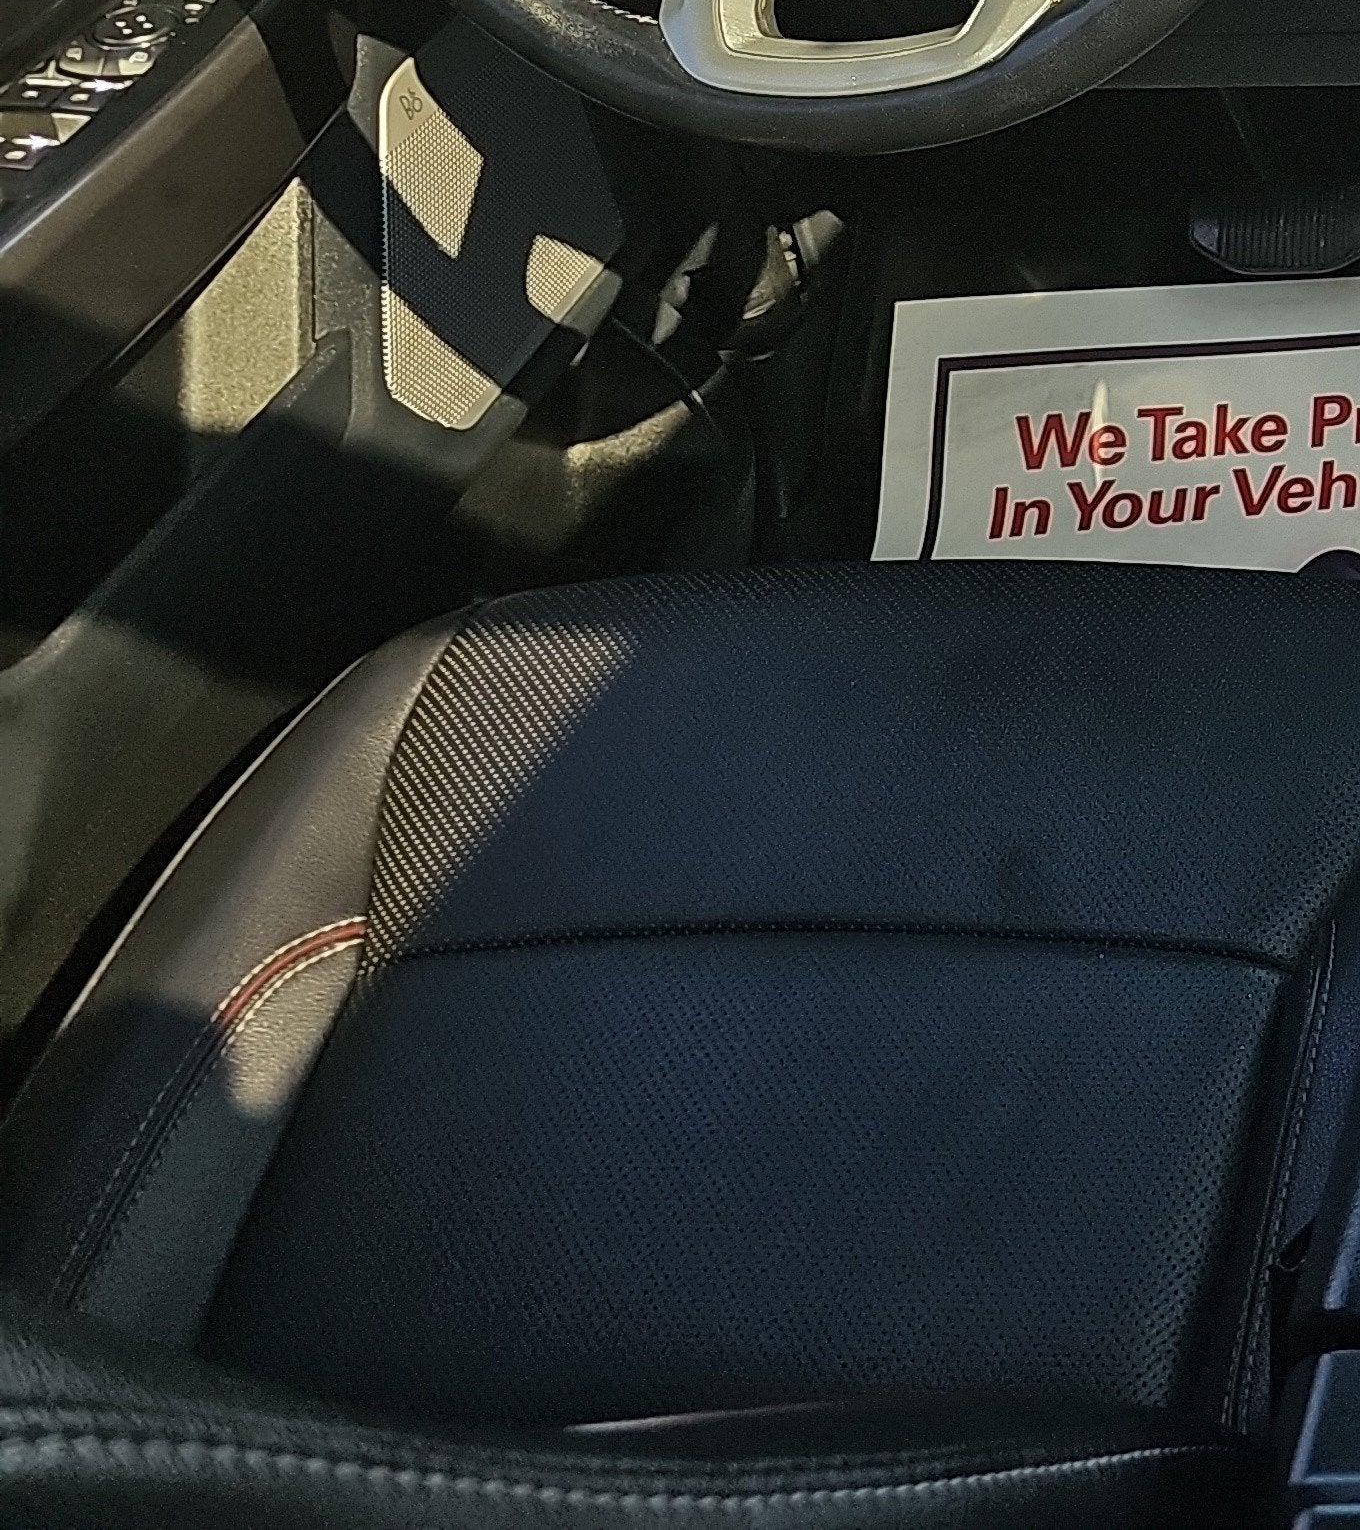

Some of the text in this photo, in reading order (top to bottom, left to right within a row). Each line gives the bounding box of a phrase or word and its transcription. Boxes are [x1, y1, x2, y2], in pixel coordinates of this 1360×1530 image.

[1015, 411, 1127, 470] We
[1136, 403, 1288, 462] Take
[988, 486, 1051, 540] In
[1066, 479, 1221, 532] Your
